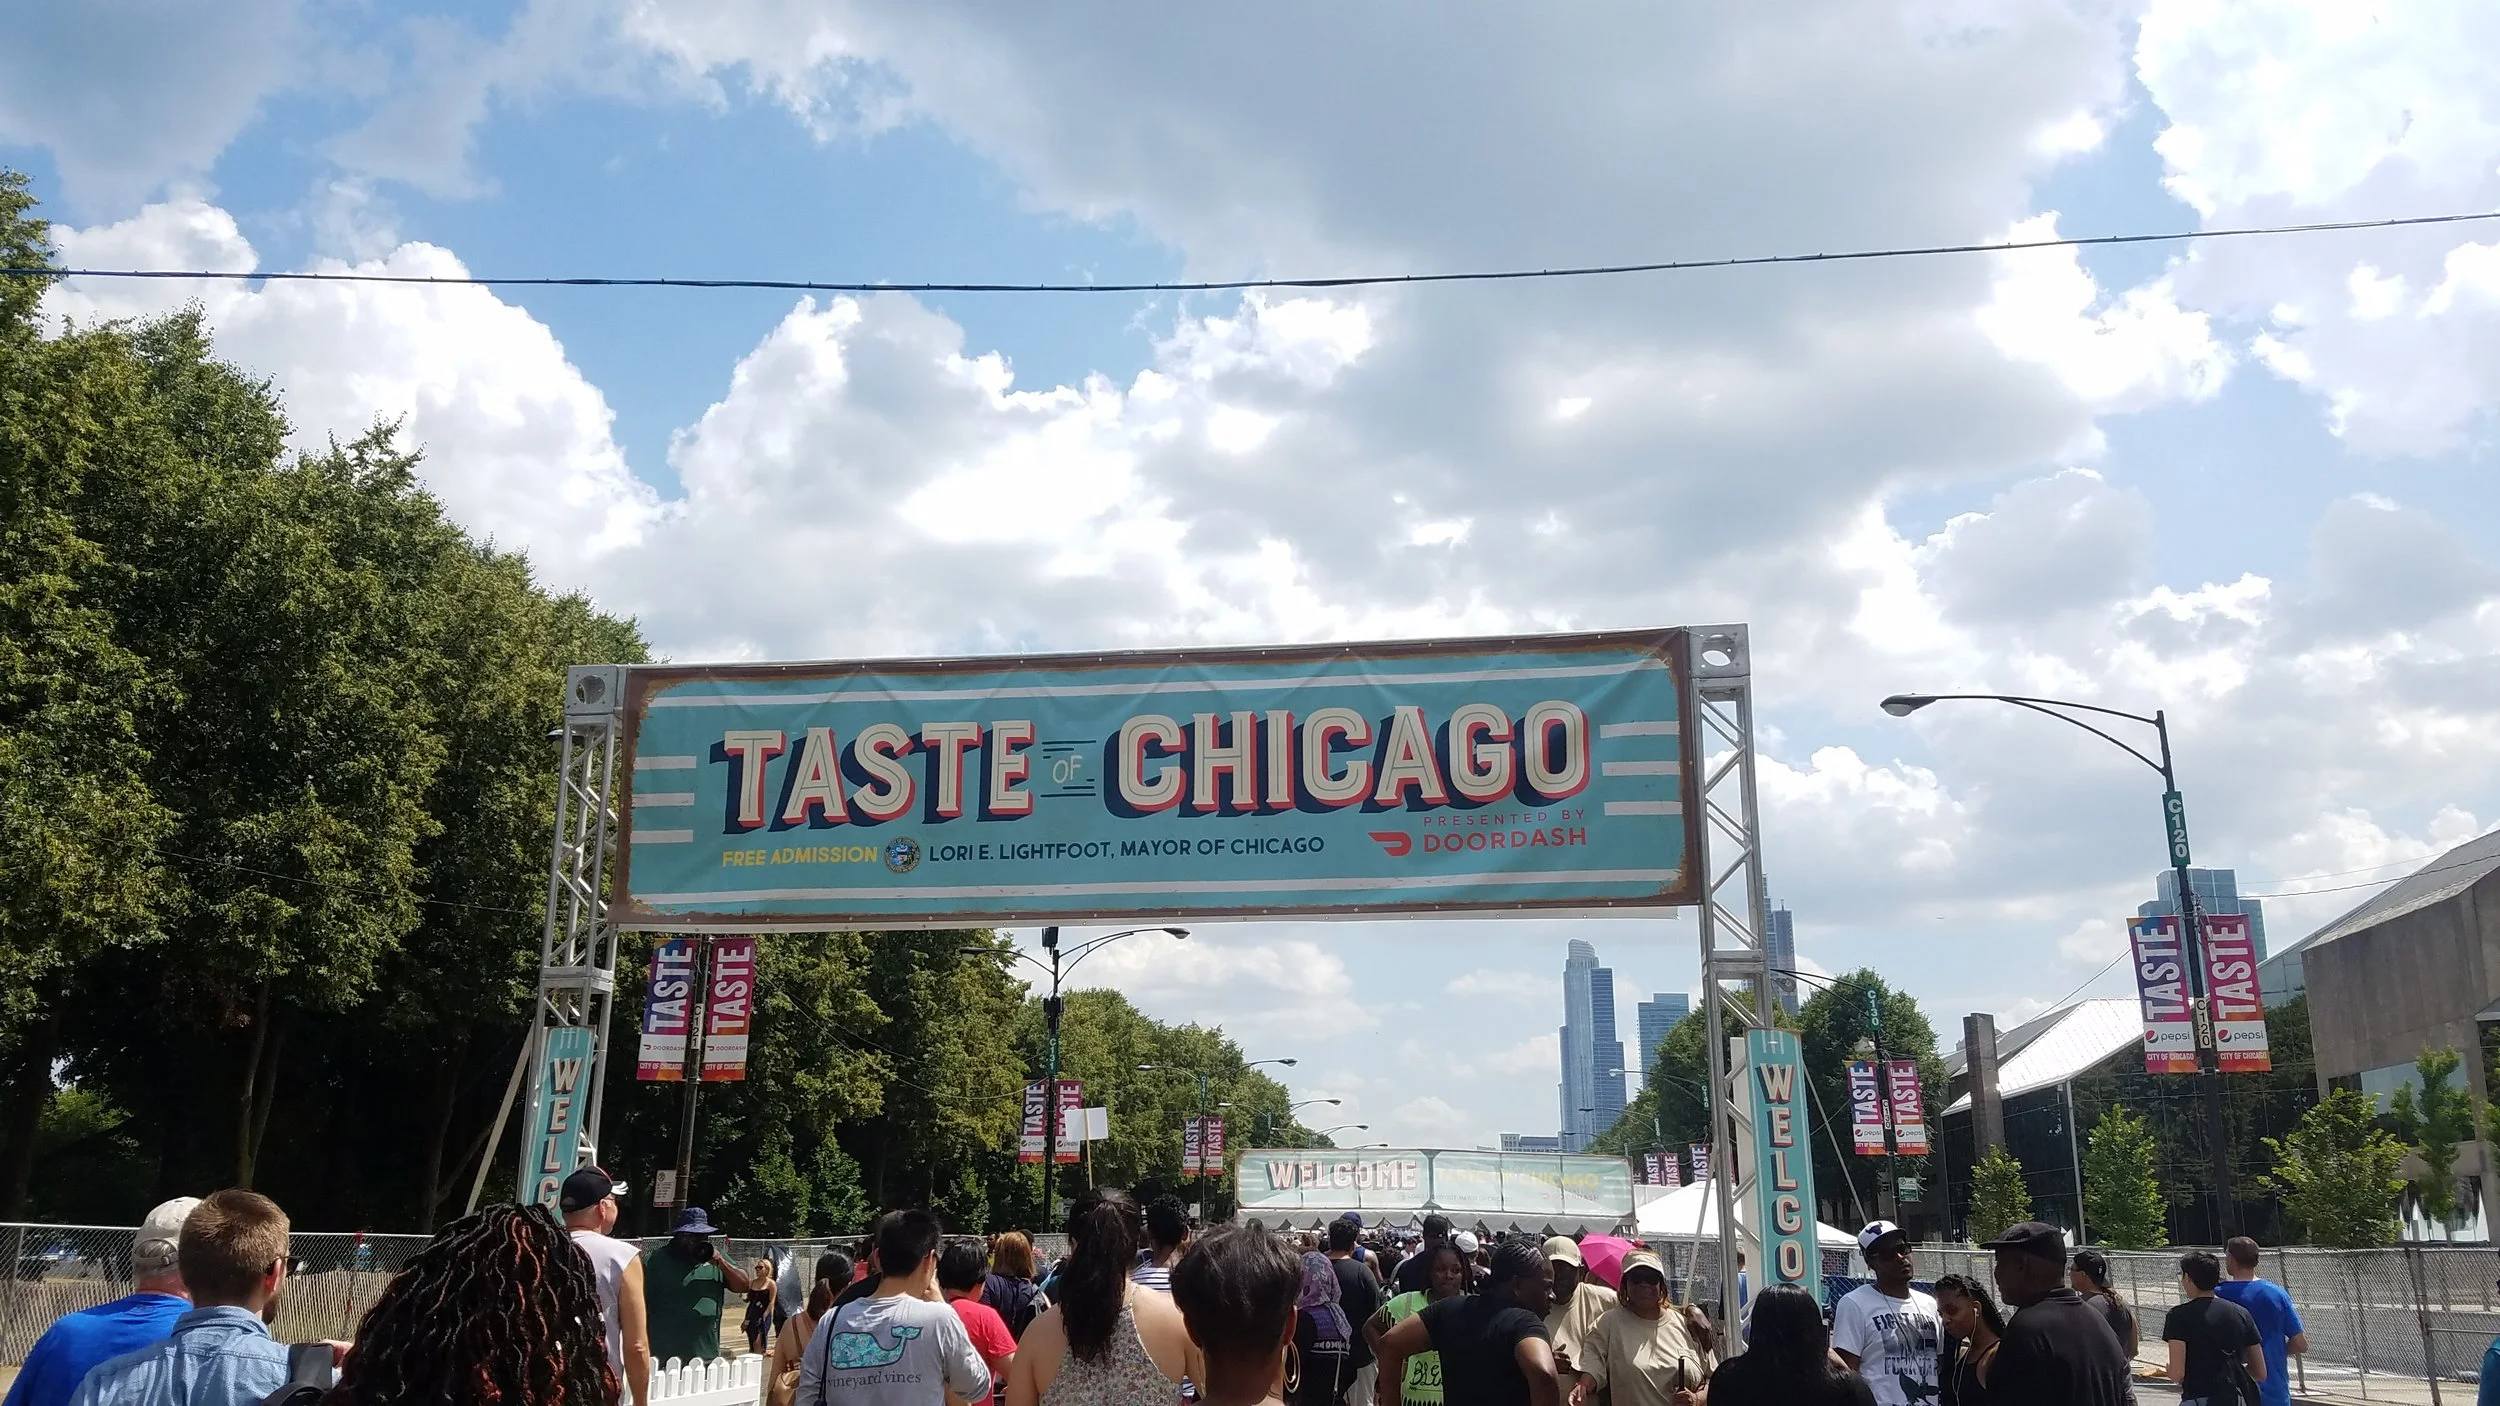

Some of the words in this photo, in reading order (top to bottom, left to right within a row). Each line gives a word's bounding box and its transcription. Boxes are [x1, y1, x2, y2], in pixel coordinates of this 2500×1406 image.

[713, 720, 1036, 833] TASTE
[1051, 754, 1084, 784] OF
[1104, 700, 1592, 818] CHICAGO
[1423, 811, 1548, 827] PRESENTED
[1561, 809, 1585, 821] BY
[2168, 798, 2188, 858] C120
[722, 850, 766, 868] FREE
[770, 846, 878, 865] ADMISSION
[929, 845, 973, 862] LORI
[979, 844, 994, 861] E.
[1000, 842, 1115, 860] LIGHTFOOT,
[1120, 839, 1192, 857] MAYOR
[1196, 838, 1226, 855] OF
[1230, 836, 1325, 854] CHICAGO
[1423, 827, 1587, 853] DOORDASH
[2135, 924, 2185, 1020] TASTE
[2205, 923, 2257, 1020] TASTE
[648, 947, 693, 1033] TASTE
[711, 946, 751, 1034] TASTE
[1867, 990, 1879, 1026] C130
[691, 1005, 702, 1047] C121
[2160, 1031, 2191, 1042] pepsi
[2196, 1000, 2210, 1046] C120
[2233, 1030, 2265, 1042] pepsi
[1048, 1037, 1057, 1070] C131
[2146, 1053, 2160, 1061] CITY
[2169, 1053, 2195, 1061] CHICAGO
[2220, 1052, 2234, 1060] CITY
[2235, 1052, 2242, 1060] OF
[2243, 1052, 2268, 1060] CHICAGO
[1023, 1084, 1045, 1136] TASTE
[1850, 1066, 1879, 1124] TASTE
[1891, 1066, 1920, 1124] TASTE
[1882, 1100, 1891, 1129] C130
[1185, 1120, 1200, 1156] TASTE
[1208, 1120, 1222, 1156] TASTE
[1265, 1159, 1417, 1191] WELCOME
[1646, 1155, 1661, 1185] TASTE
[1664, 1155, 1680, 1185] TASTE
[1691, 1146, 1708, 1182] TASTE
[1756, 1062, 1808, 1286] WELCO
[827, 1371, 882, 1390] vineyard
[883, 1371, 922, 1384] vines
[1410, 1360, 1441, 1387] BLE
